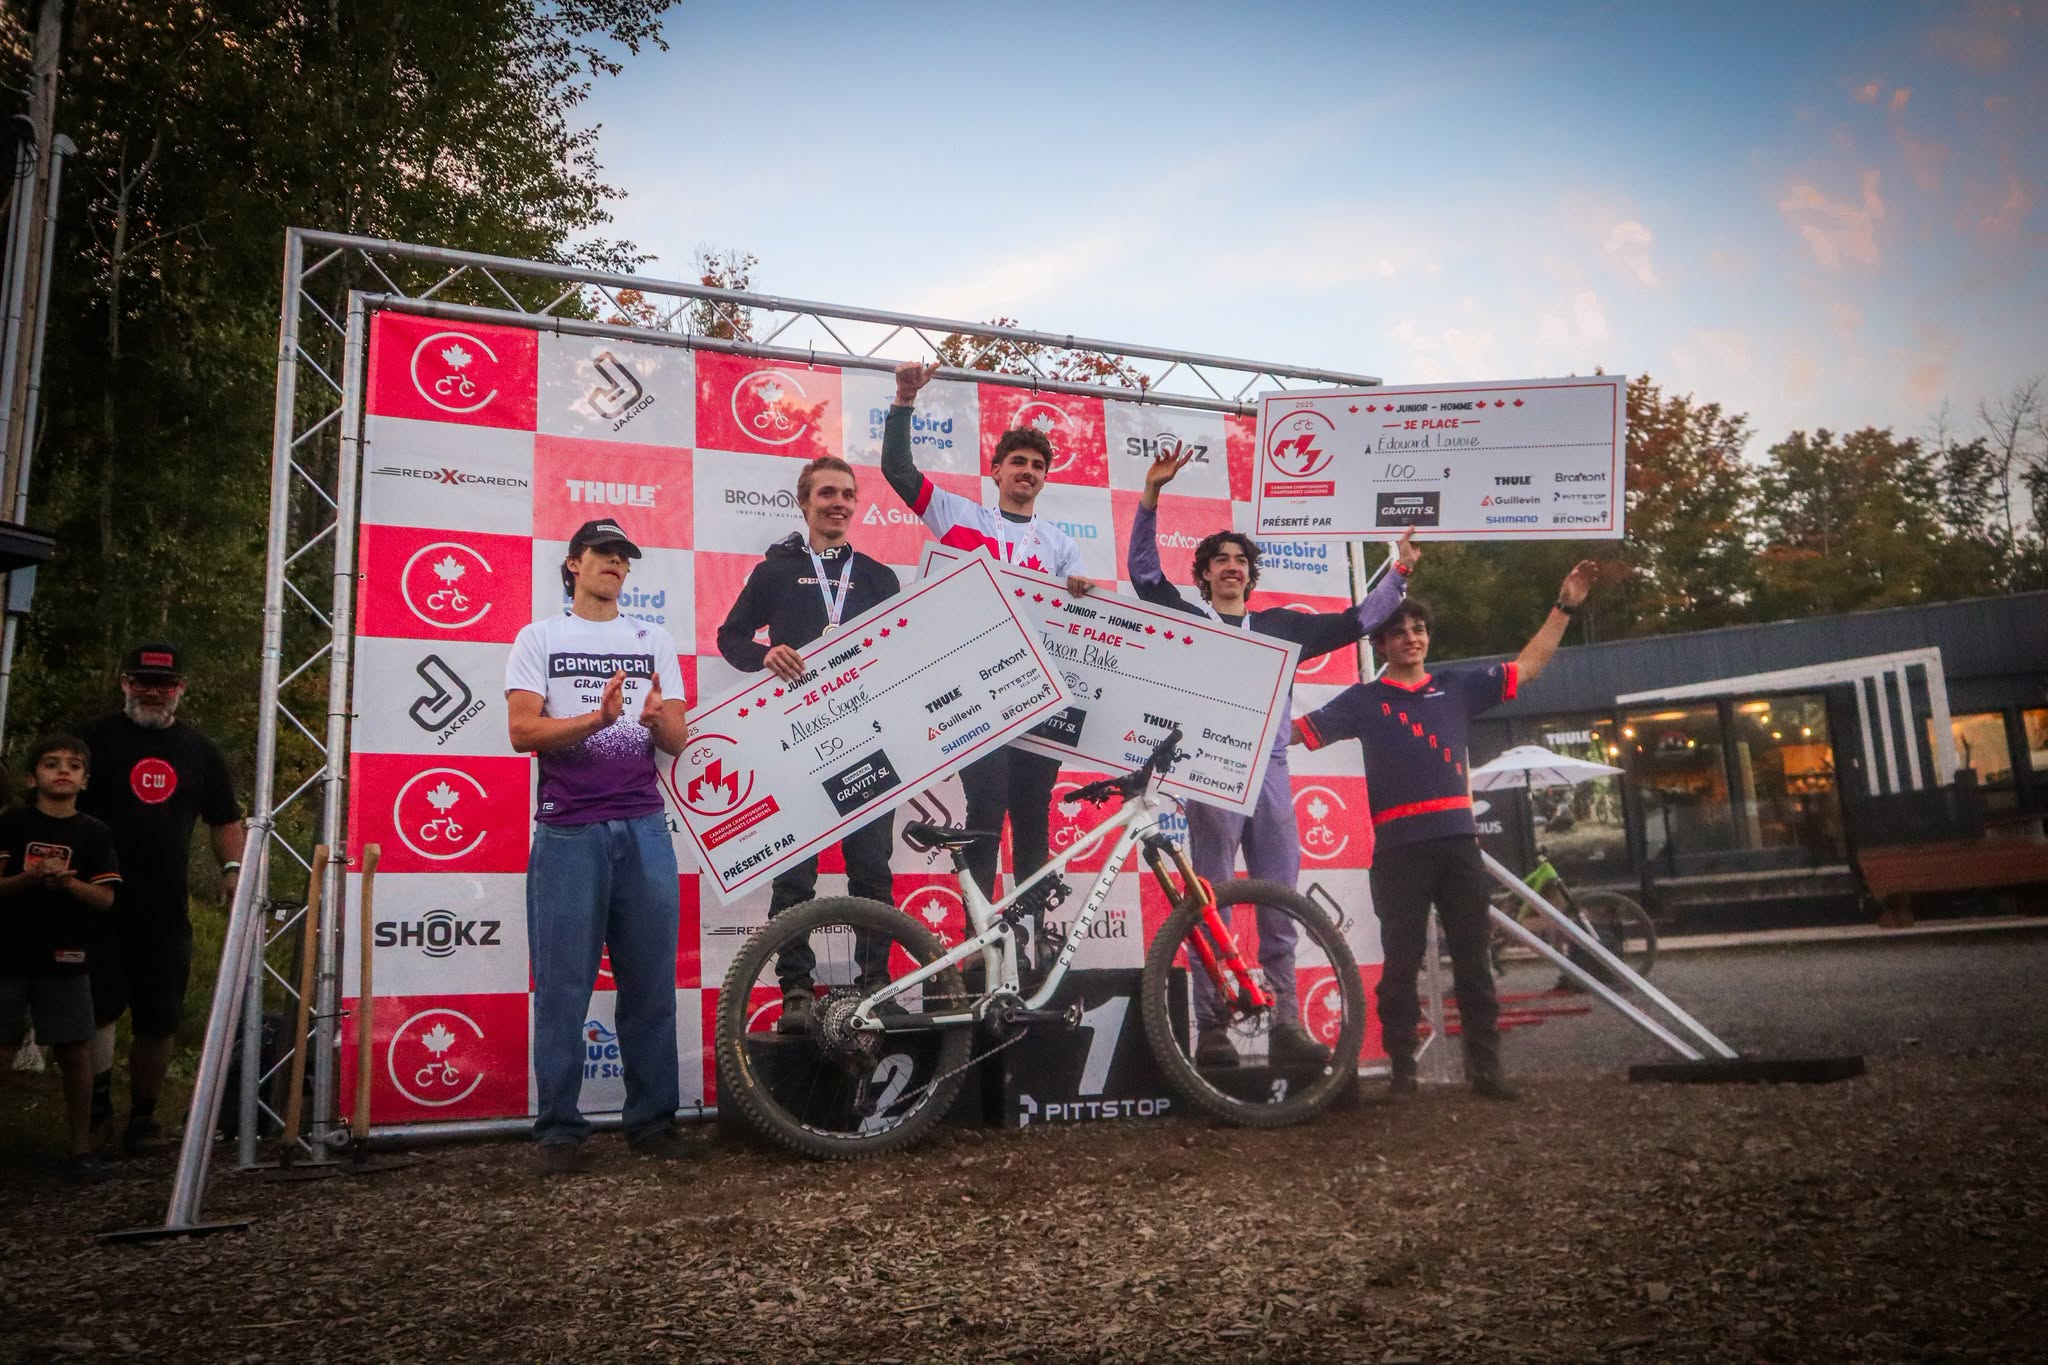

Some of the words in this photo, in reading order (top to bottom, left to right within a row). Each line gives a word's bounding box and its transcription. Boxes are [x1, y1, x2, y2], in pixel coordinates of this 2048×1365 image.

[613, 395, 655, 432] JAKROO
[1396, 404, 1428, 413] JUNIOR
[1440, 402, 1473, 411] HOMME
[1404, 420, 1417, 430] 3E
[1421, 418, 1460, 429] PLACE
[1385, 463, 1416, 479] 100
[1443, 467, 1451, 479] $
[1494, 476, 1531, 486] THULE
[566, 480, 656, 507] THULE
[725, 489, 800, 509] BROMON
[1495, 496, 1541, 505] Guillevin
[1262, 515, 1309, 527] PRÉSENTÉ
[1312, 517, 1331, 526] PAR
[1381, 506, 1423, 515] GRAVITY
[1486, 515, 1538, 524] SHIMANO
[1283, 559, 1328, 574] Storage
[1063, 603, 1097, 619] JUNIOR
[1108, 615, 1143, 632] HOMME
[1068, 623, 1081, 635] 1E
[1083, 627, 1123, 647] PLACE
[554, 658, 651, 674] COMMENCAL
[787, 669, 819, 693] JUNIOR
[828, 644, 862, 669] HOMME
[1083, 644, 1119, 670] Blake
[624, 680, 638, 689] SL
[803, 690, 820, 706] 2E
[820, 667, 860, 696] PLACE
[998, 668, 1037, 694] PITTSTOP
[925, 687, 962, 713] THULE
[1001, 683, 1051, 721] BROMONT
[1094, 688, 1103, 700] $
[437, 699, 486, 745] JAKROO
[781, 740, 790, 751] À
[791, 713, 831, 741] Alexis
[828, 683, 869, 717] Gagné
[939, 704, 982, 731] Guillevin
[1065, 723, 1076, 734] SL
[1143, 713, 1180, 730] THULE
[815, 737, 844, 761] 150
[873, 720, 882, 733] $
[941, 722, 991, 755] SHIMANO
[1205, 753, 1247, 769] PITTSTOP
[837, 772, 876, 801] GRAVITY
[878, 767, 890, 779] SL
[1189, 773, 1244, 794] BROMONT
[723, 844, 774, 881] PRÉSENTÉ
[774, 833, 796, 852] PAR
[1060, 855, 1125, 966] COMMENCAL
[374, 919, 501, 947] SHOKZ
[1078, 996, 1130, 1096] 1
[857, 1053, 914, 1135] 2
[1045, 1098, 1171, 1121] PITTSTOP
